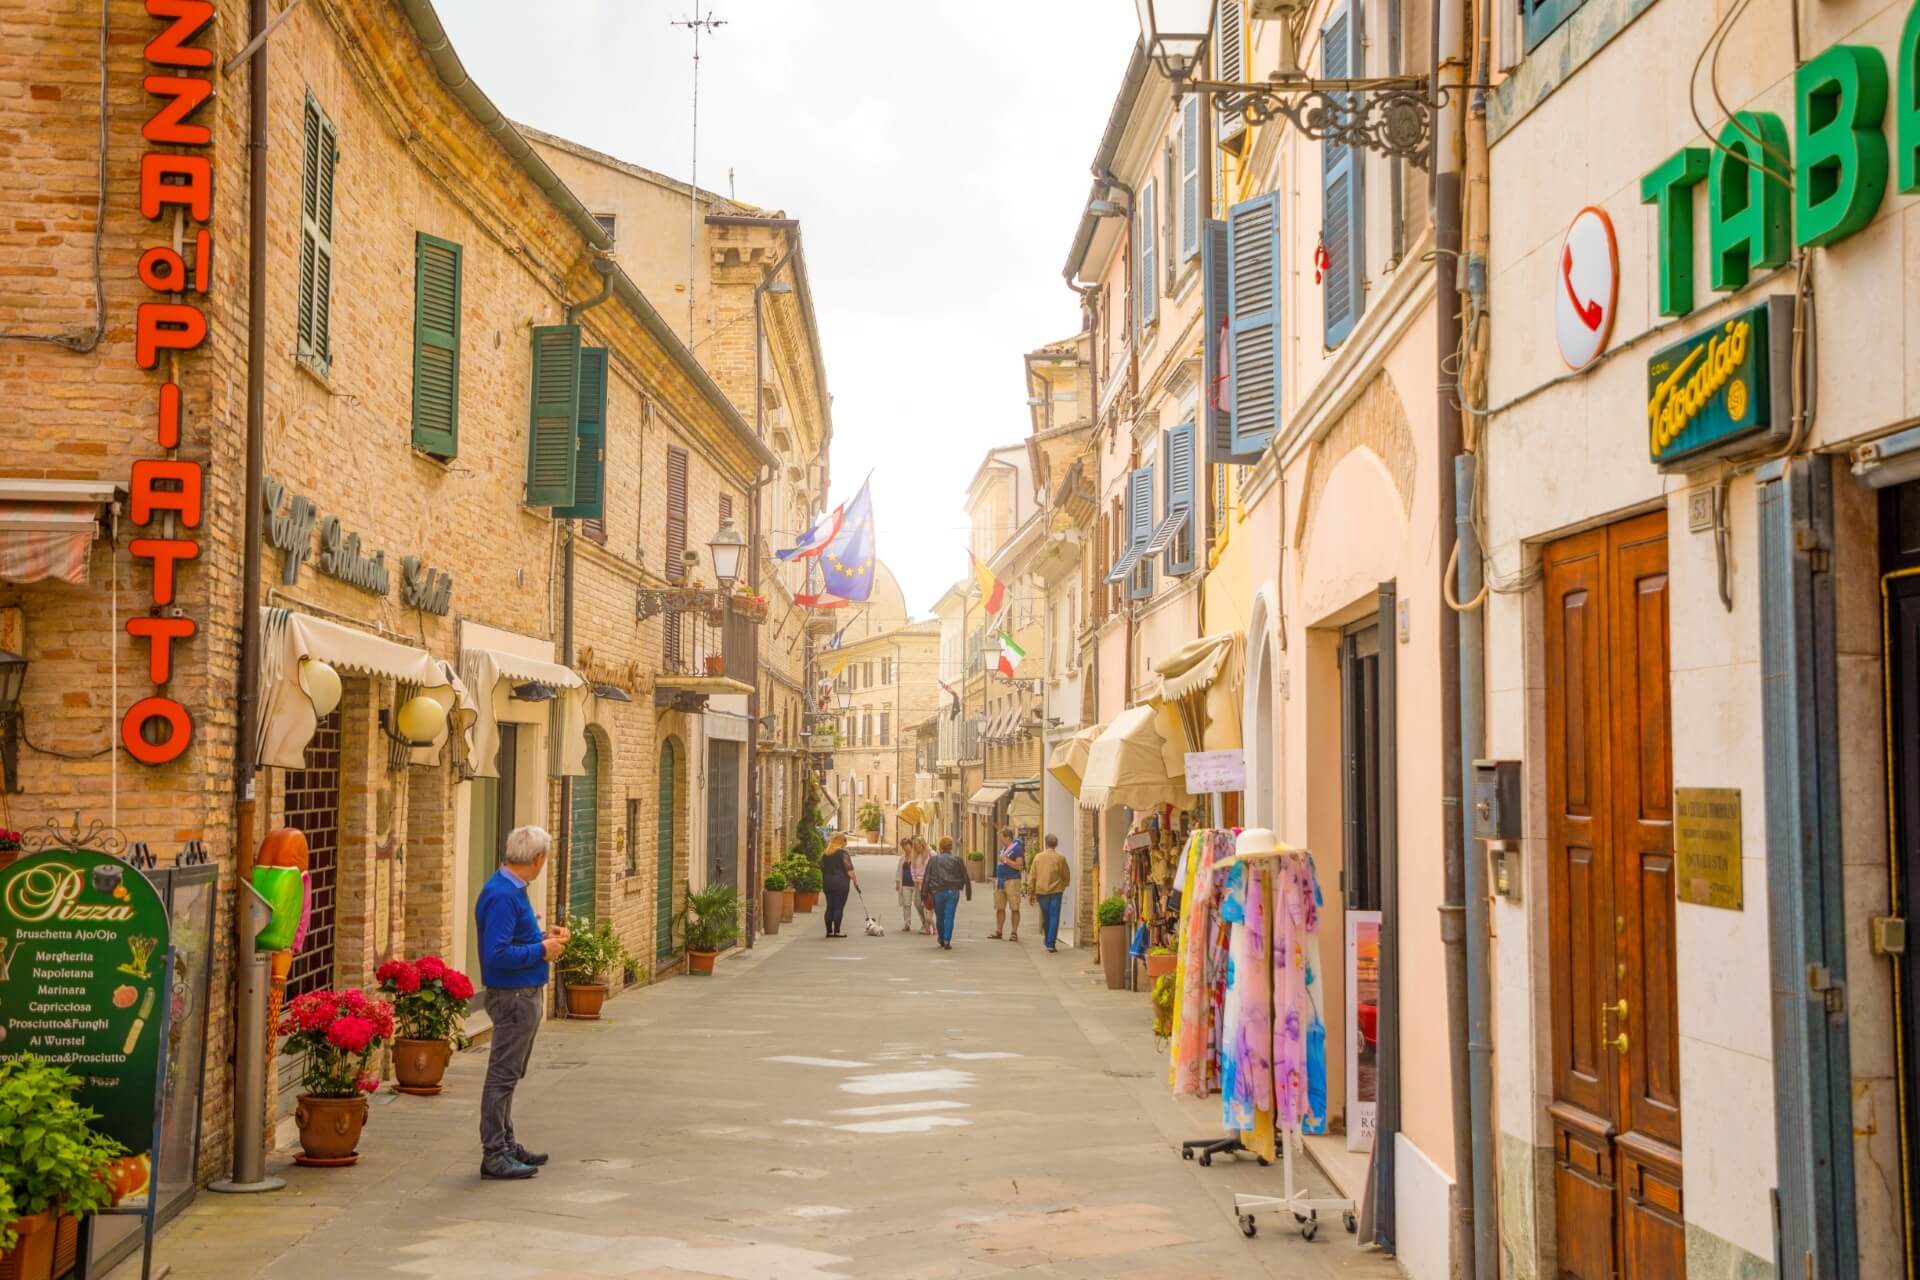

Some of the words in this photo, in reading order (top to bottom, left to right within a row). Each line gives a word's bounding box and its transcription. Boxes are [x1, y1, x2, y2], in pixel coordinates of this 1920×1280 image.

[1648, 320, 1749, 457] Totocalcio
[120, 302, 209, 765] PIATTO
[5, 862, 136, 922] Pizza
[15, 928, 73, 940] Bruschetta
[75, 929, 118, 942] Ajo/Ojo
[32, 967, 94, 980] Napoletana
[37, 984, 86, 996] Marinara
[28, 1001, 92, 1014] Capricciosa
[8, 1018, 109, 1031] Prosciutto&Funghi
[44, 1035, 86, 1046] Wurstel
